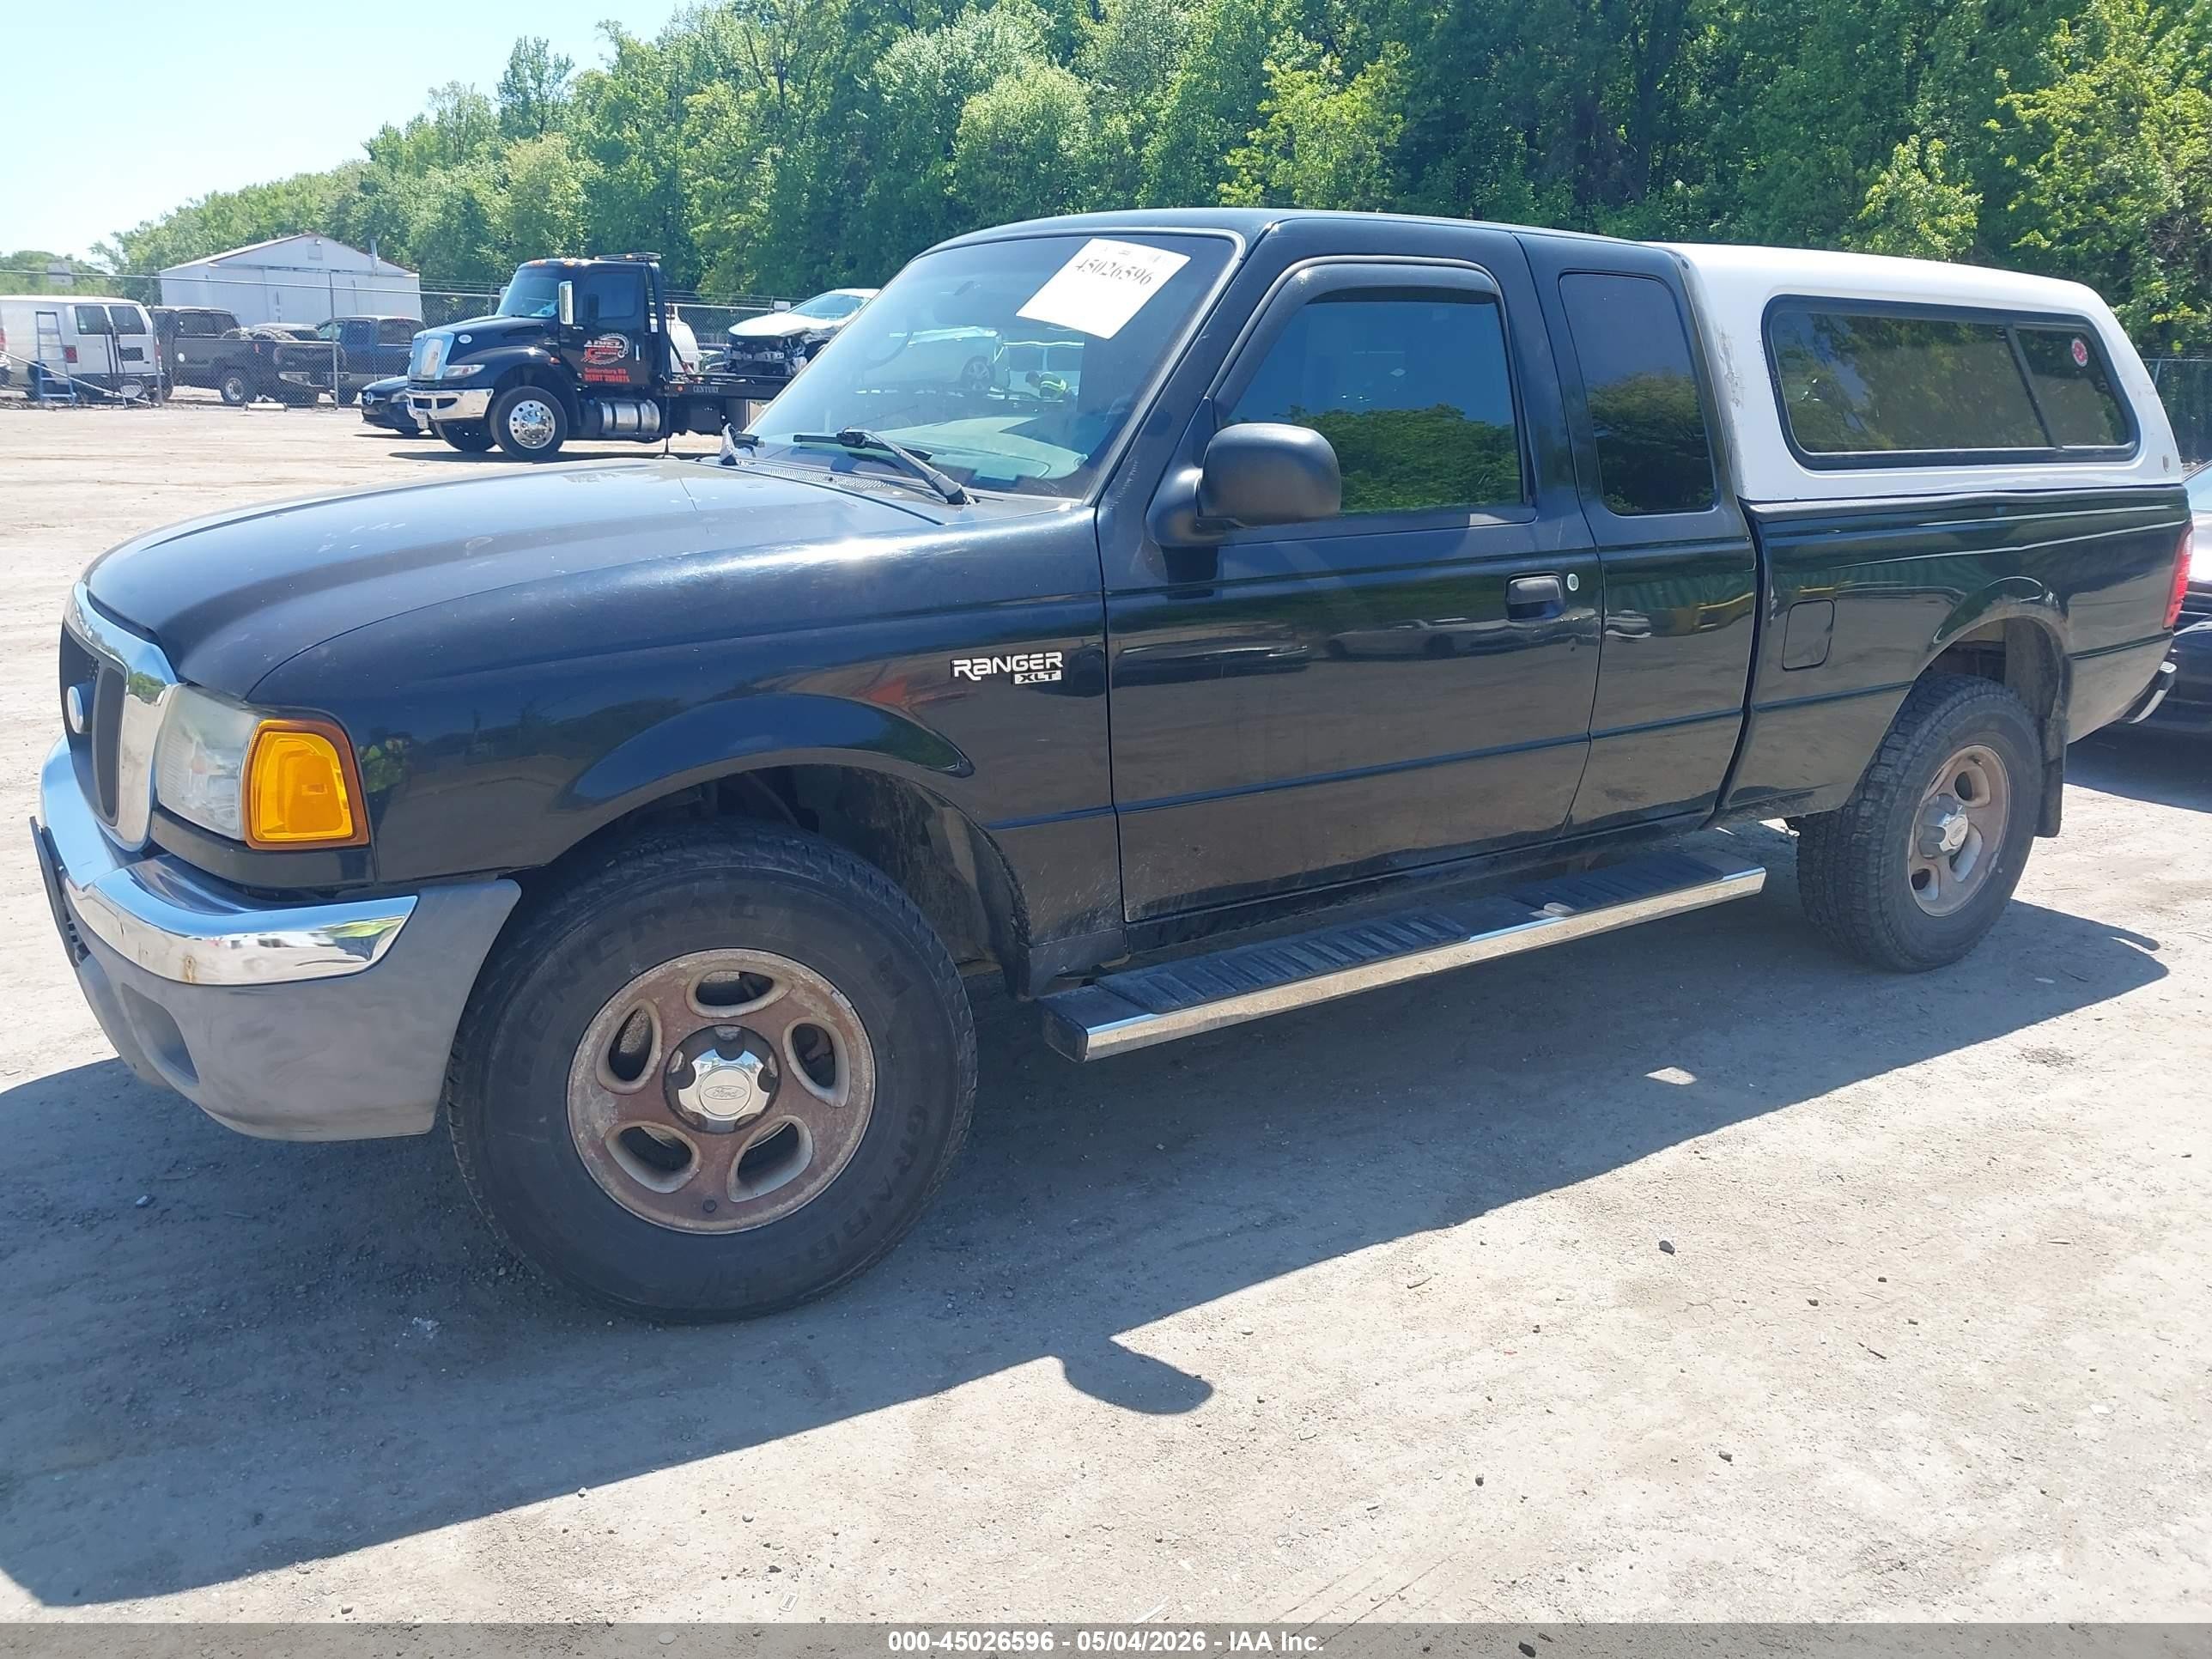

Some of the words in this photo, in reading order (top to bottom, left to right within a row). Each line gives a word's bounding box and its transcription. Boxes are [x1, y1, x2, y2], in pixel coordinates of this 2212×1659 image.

[1075, 258, 1154, 285] 45026596
[693, 386, 720, 394] CENTURY
[953, 651, 1064, 681] RANGER
[1020, 672, 1057, 683] XLT
[713, 1086, 738, 1098] Ford
